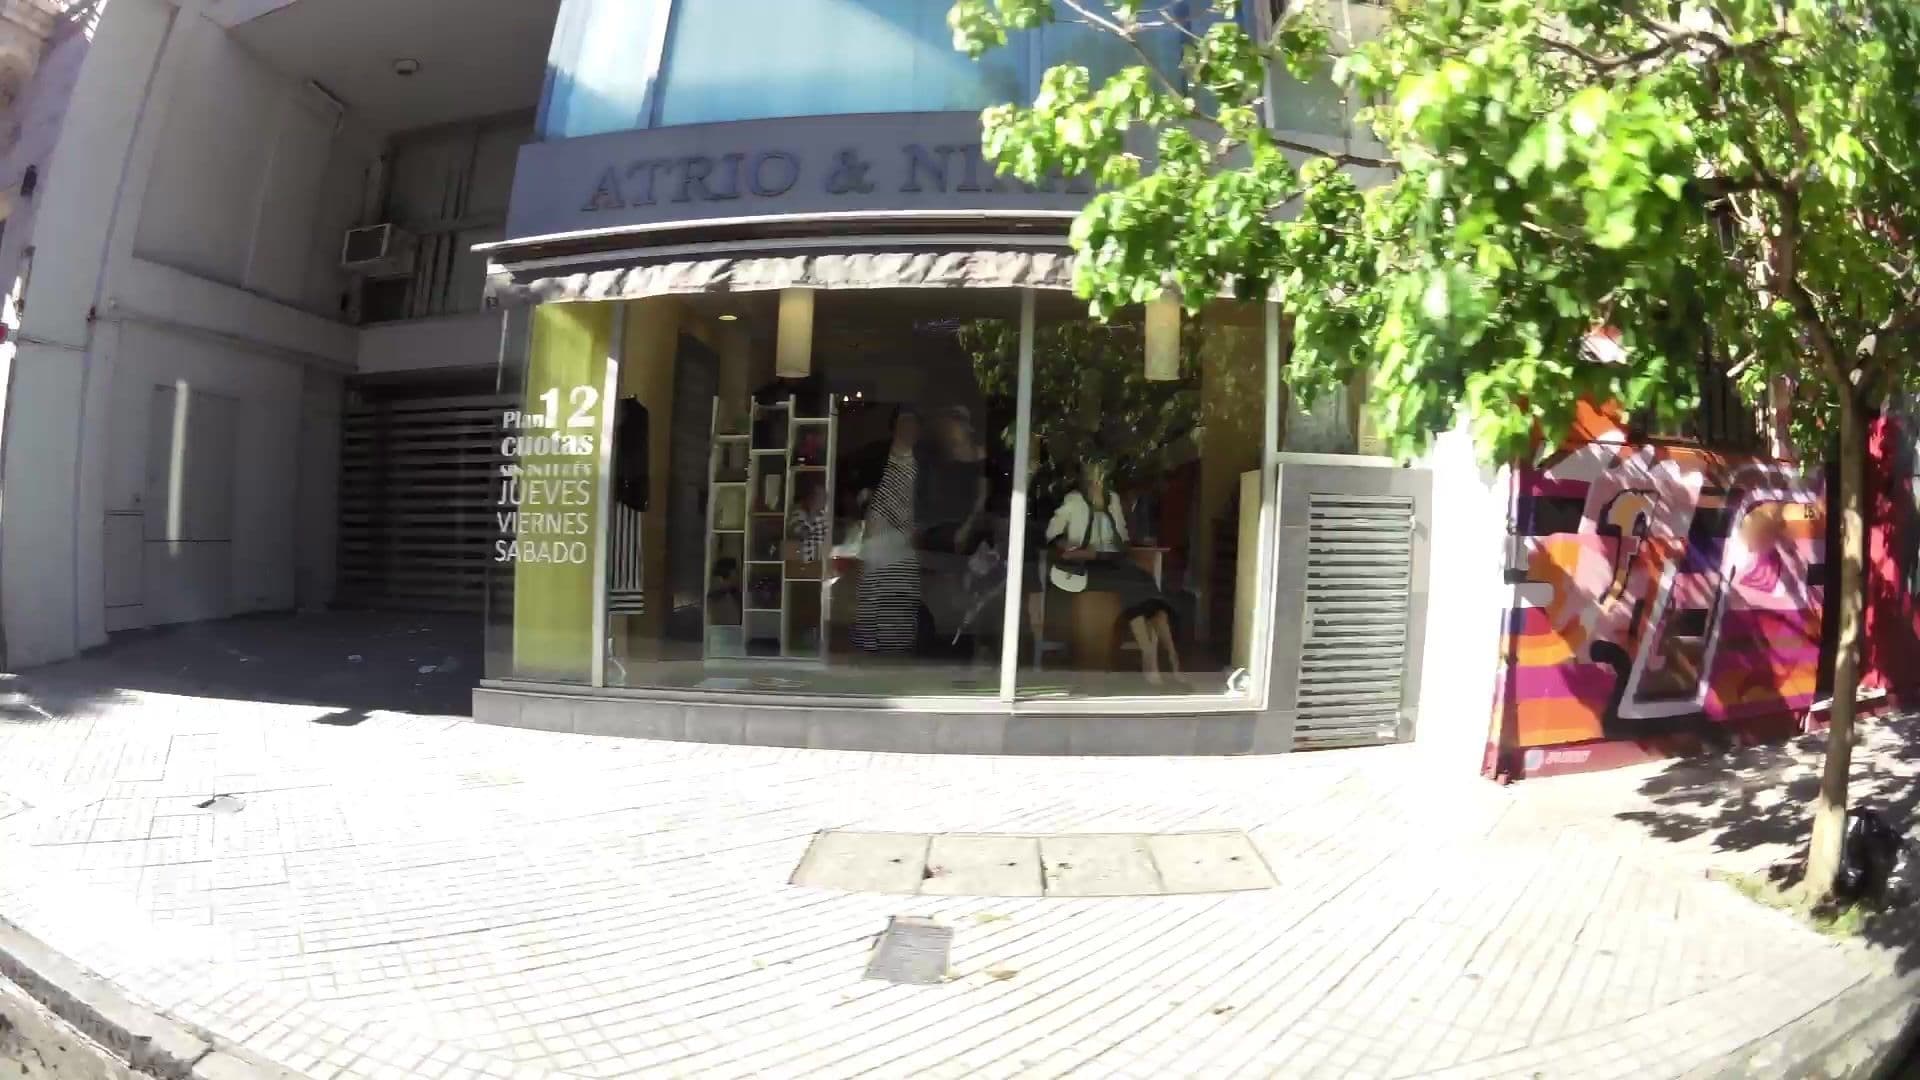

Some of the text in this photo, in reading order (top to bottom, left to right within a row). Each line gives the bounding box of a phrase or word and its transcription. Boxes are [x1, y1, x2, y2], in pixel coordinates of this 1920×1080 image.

[581, 151, 799, 211] ATRIO
[824, 147, 873, 194] &
[503, 385, 598, 429] Plan 12
[501, 431, 593, 456] cuotas
[498, 480, 590, 505] JUEVES
[497, 512, 589, 535] VIERNES
[495, 540, 587, 563] SABADO
